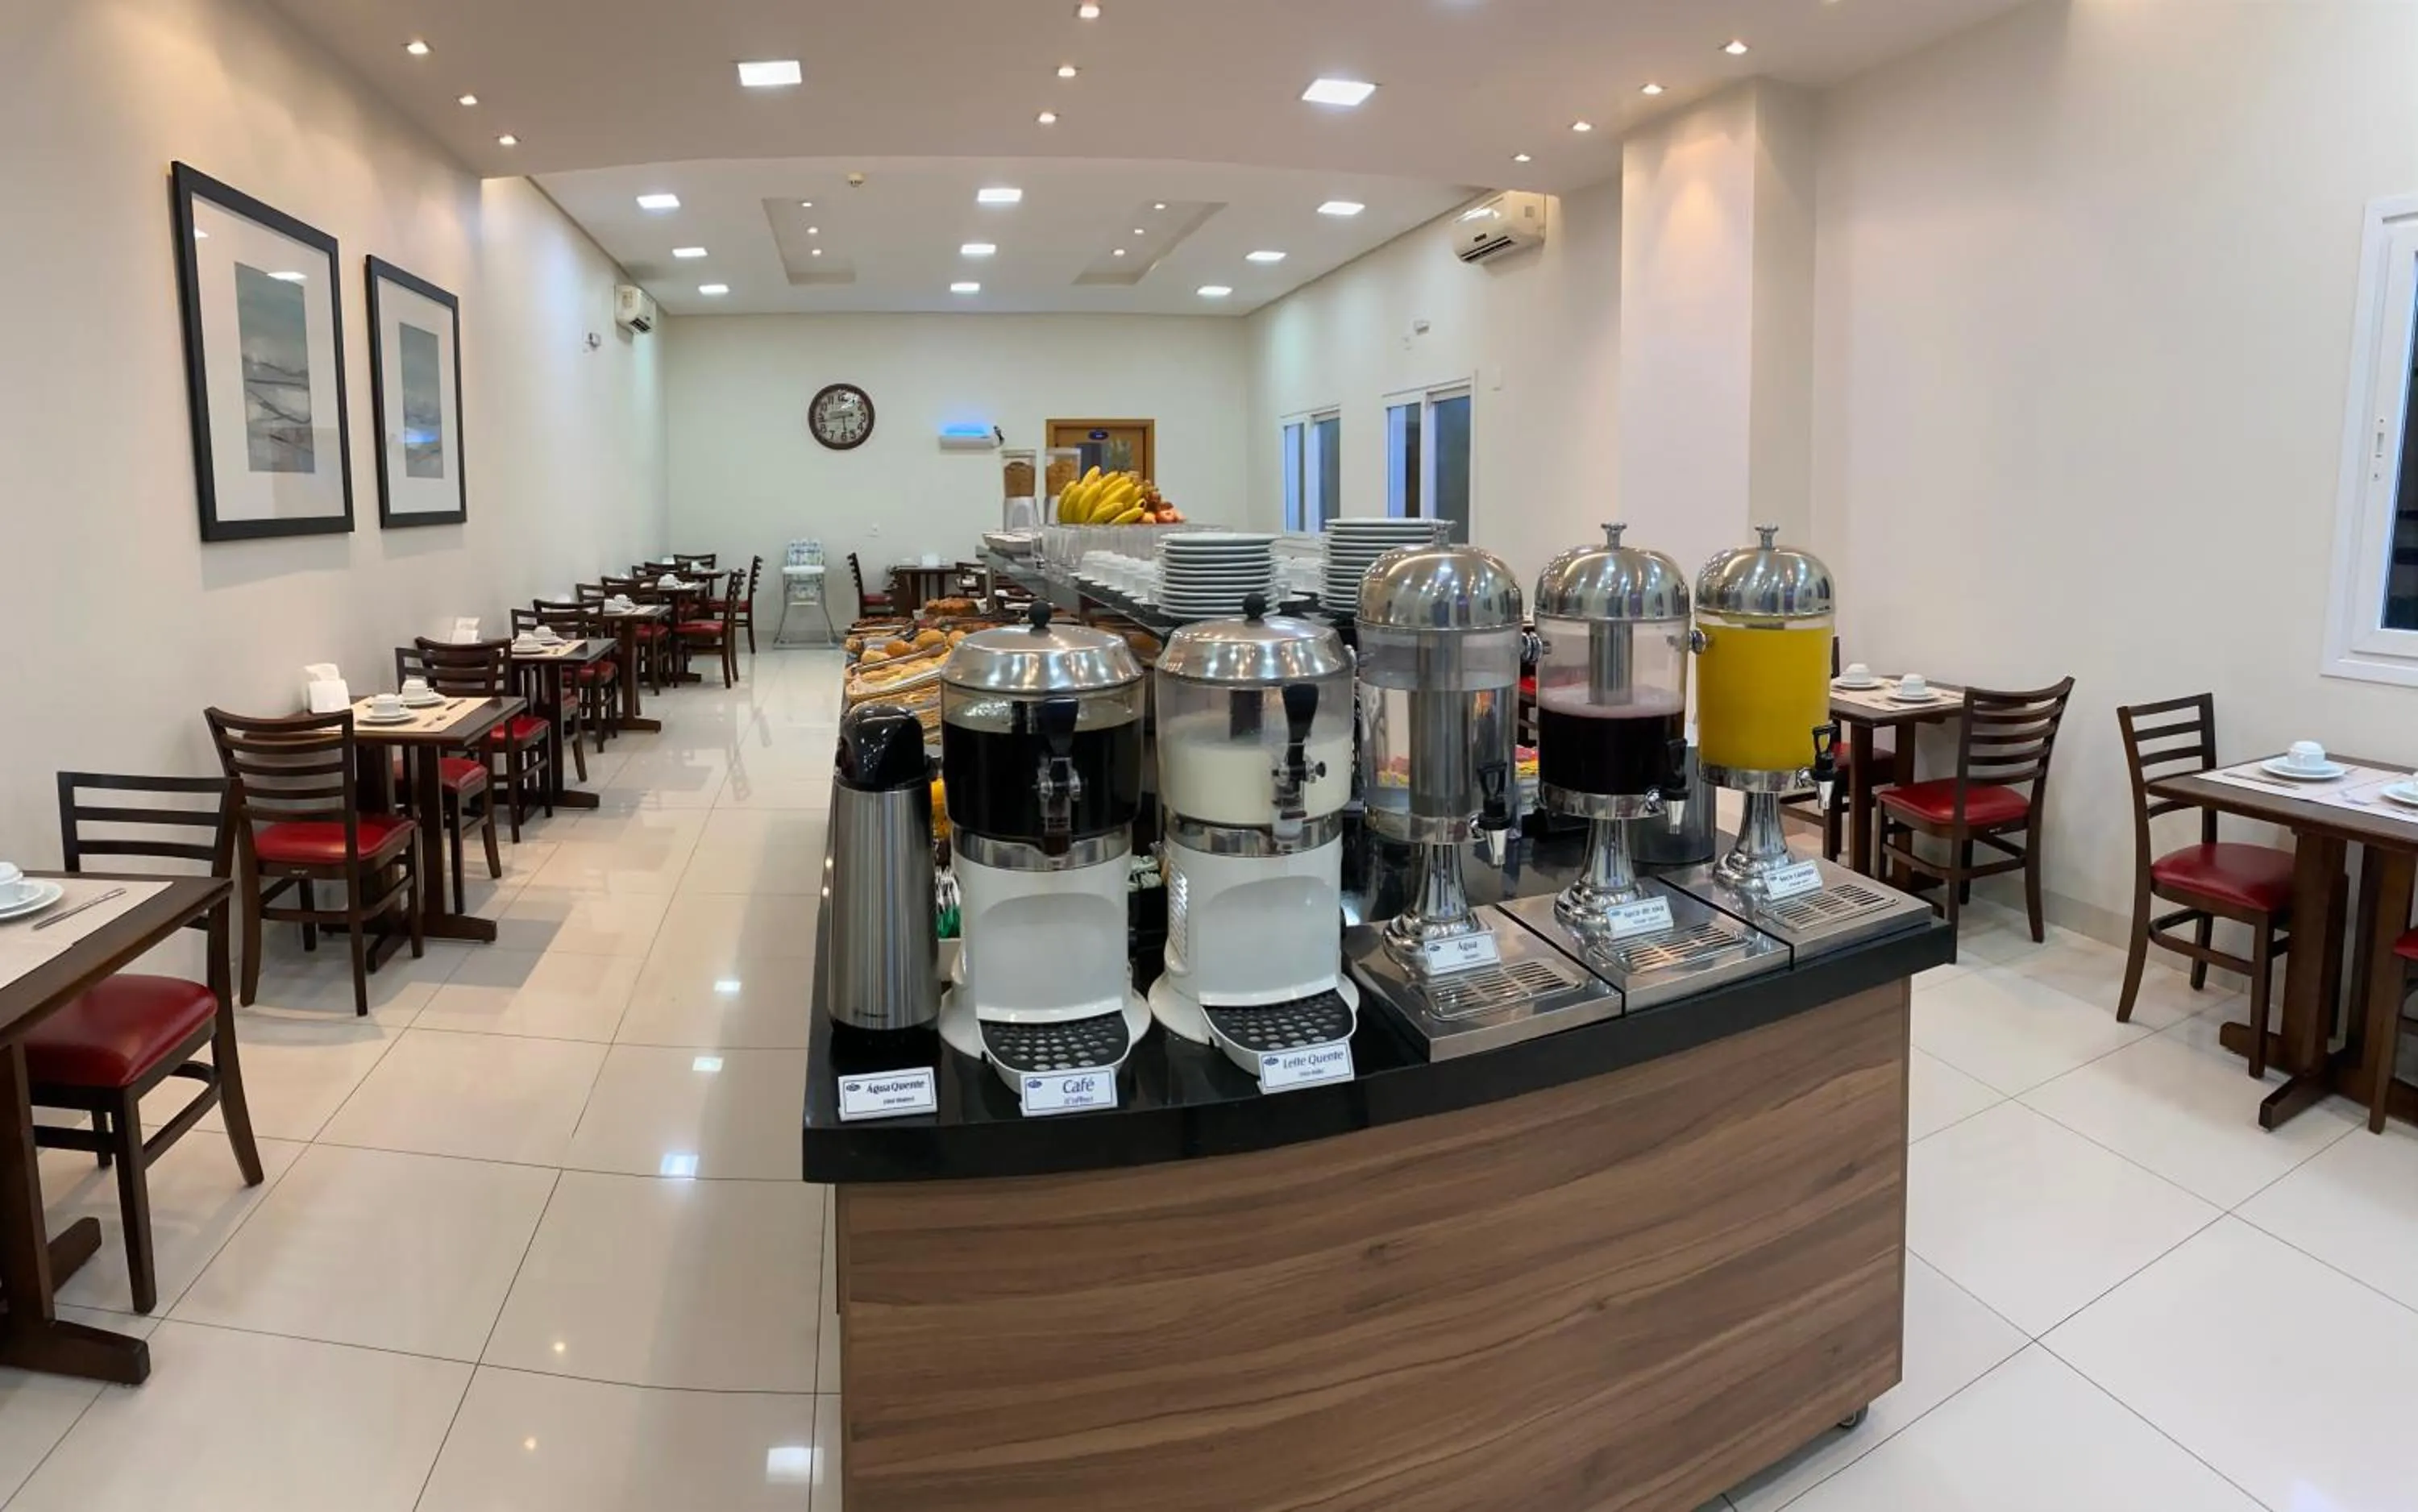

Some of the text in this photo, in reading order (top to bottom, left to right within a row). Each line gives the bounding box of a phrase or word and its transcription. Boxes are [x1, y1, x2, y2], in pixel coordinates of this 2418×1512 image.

[1308, 1050, 1344, 1065] Quente
[891, 1080, 925, 1092] Quente
[1062, 1077, 1095, 1094] Café
